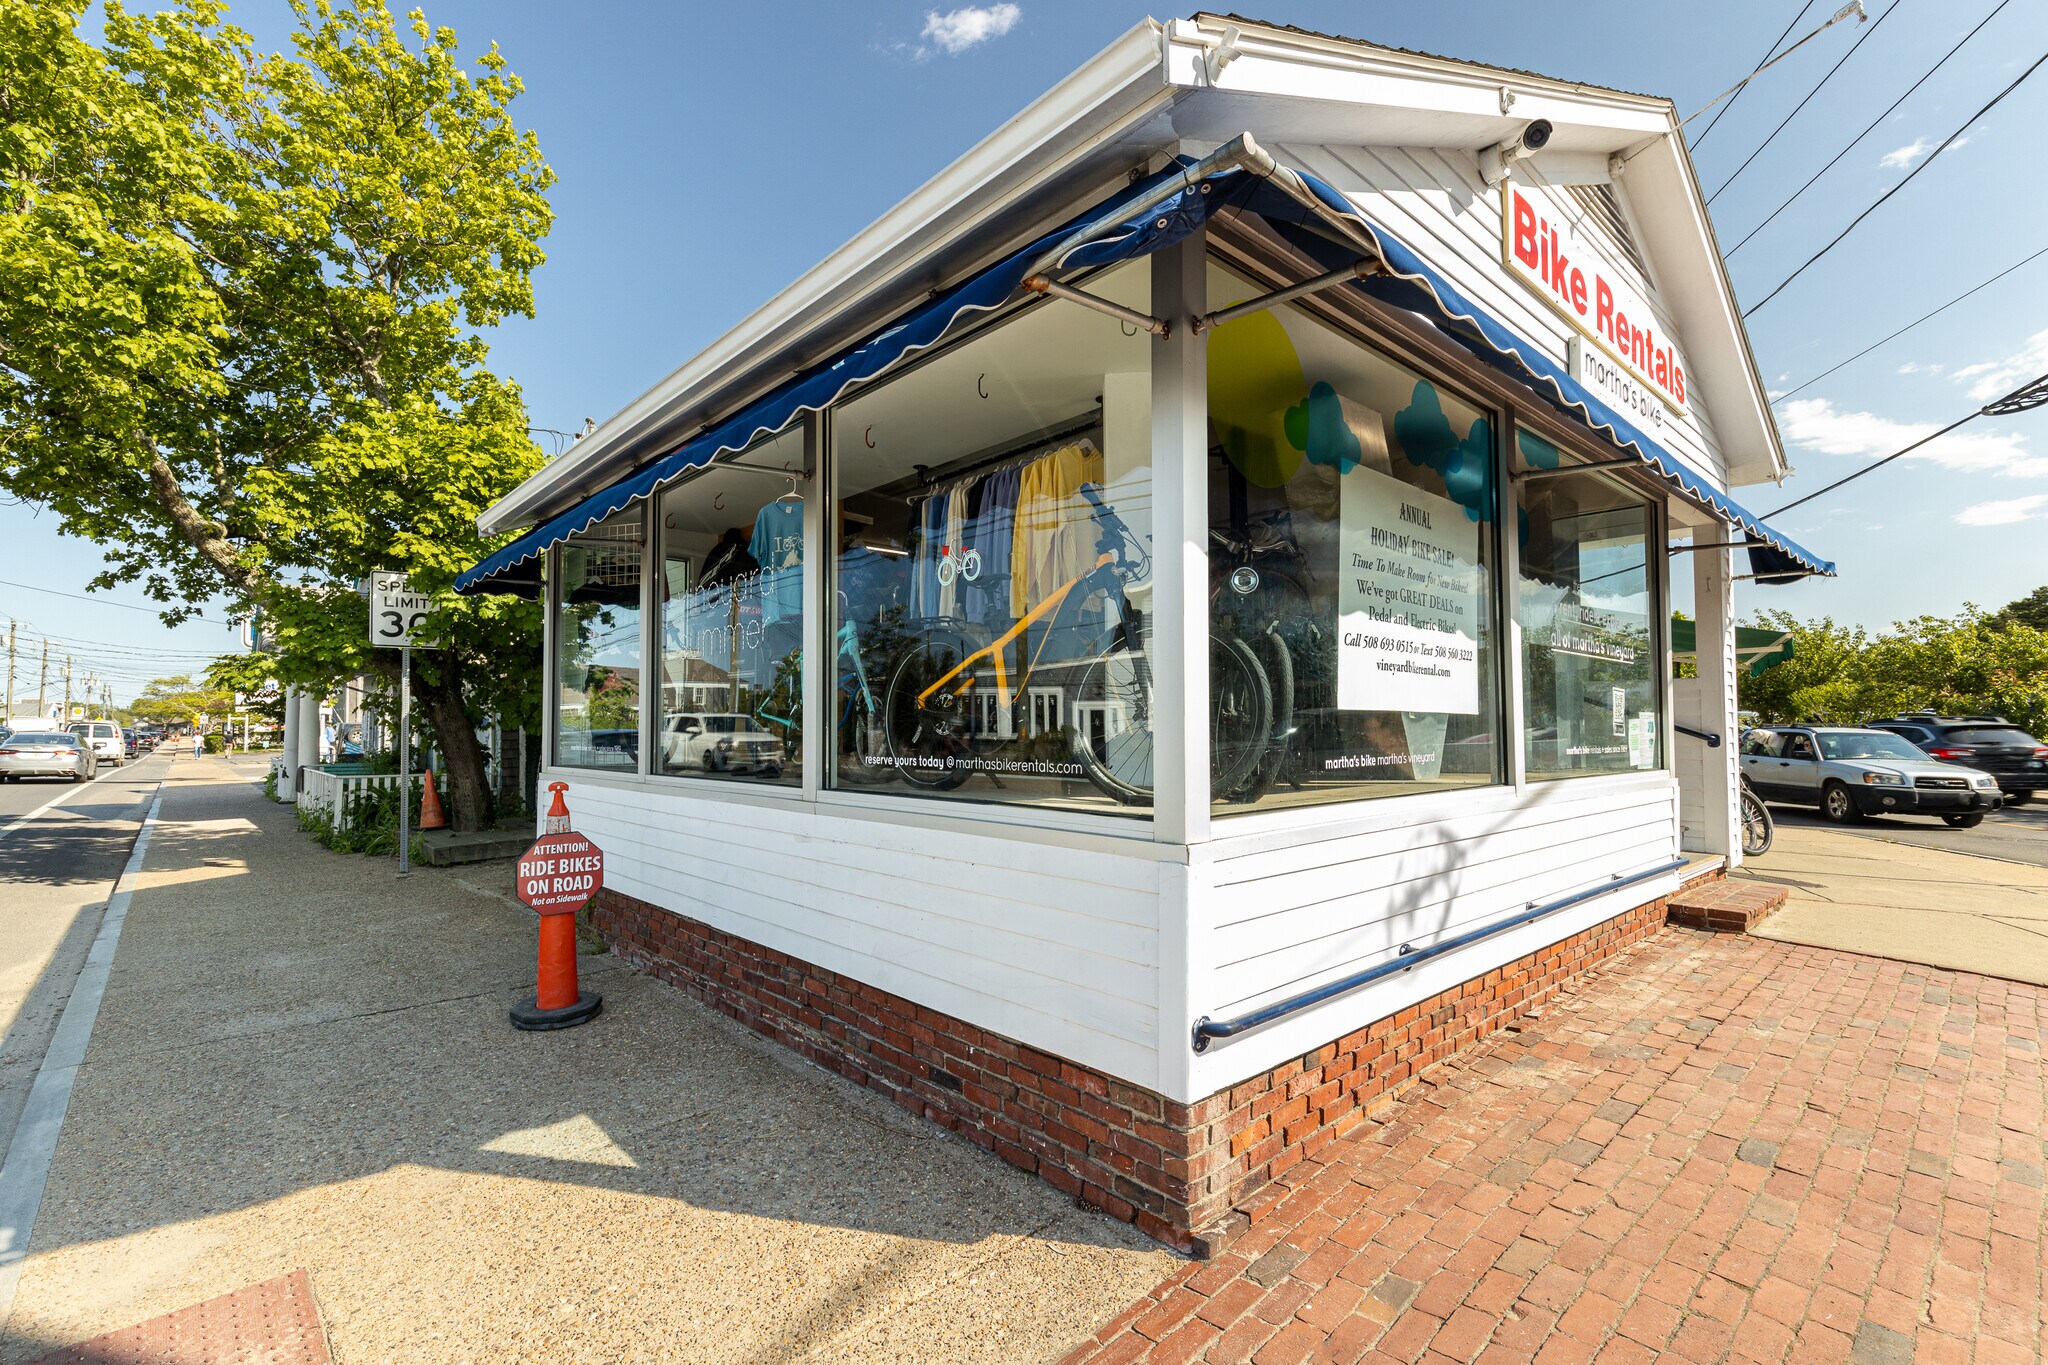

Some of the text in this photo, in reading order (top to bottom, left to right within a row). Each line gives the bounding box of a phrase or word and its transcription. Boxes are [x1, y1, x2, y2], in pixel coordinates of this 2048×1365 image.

[1513, 190, 1685, 405] Bike Rentals
[1585, 352, 1662, 428] martha's bike
[1399, 502, 1432, 529] ANNUAL
[1371, 527, 1455, 568] HOLIDAY BIKE SALE!
[1351, 553, 1373, 570] Time
[1376, 558, 1386, 573] To
[1387, 562, 1405, 578] Make
[1407, 567, 1426, 583] Room
[1425, 571, 1436, 588] for
[1437, 574, 1450, 590] New
[384, 596, 429, 609] LIMIT
[1356, 579, 1464, 615] We've got GREAT DEALS on
[1368, 606, 1456, 635] Pedal and Electric Bikes!
[1344, 632, 1361, 648] Call
[1363, 634, 1378, 649] 508
[1380, 636, 1395, 651] 693
[1396, 638, 1413, 654] 0515
[1421, 643, 1433, 656] Text
[1434, 645, 1446, 658] 508
[1447, 646, 1459, 659] 560
[1459, 648, 1473, 662] 3222
[1551, 628, 1561, 646] all
[865, 755, 893, 765] reserve
[894, 756, 917, 768] yours
[919, 755, 944, 770] today
[1325, 751, 1435, 770] martha's bike martha's vineyard
[533, 841, 589, 856] ATTENTION!
[520, 856, 601, 878] RIDE BIKES
[527, 875, 593, 895] ON ROAD
[531, 897, 545, 906] Not
[556, 892, 588, 903] Sidewalk
